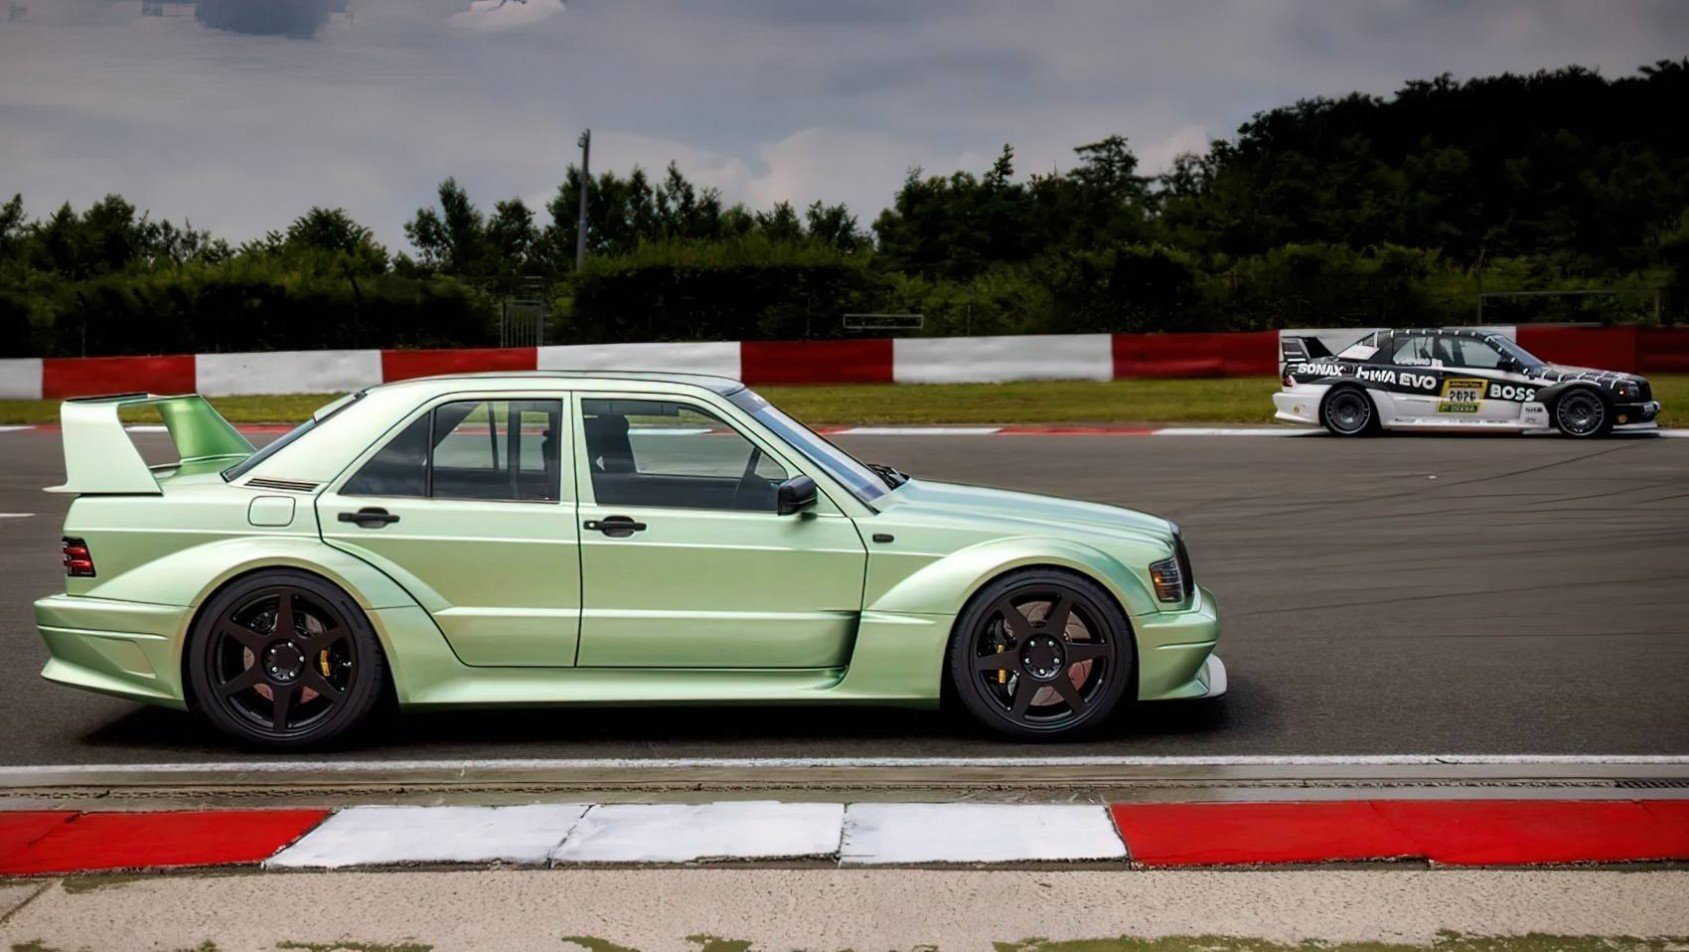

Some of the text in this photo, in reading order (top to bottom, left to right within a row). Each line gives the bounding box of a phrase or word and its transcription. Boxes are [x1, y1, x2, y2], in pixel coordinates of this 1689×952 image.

[1298, 363, 1344, 376] SONAX
[1356, 366, 1436, 390] HWA EVO
[1490, 384, 1536, 401] BOSS
